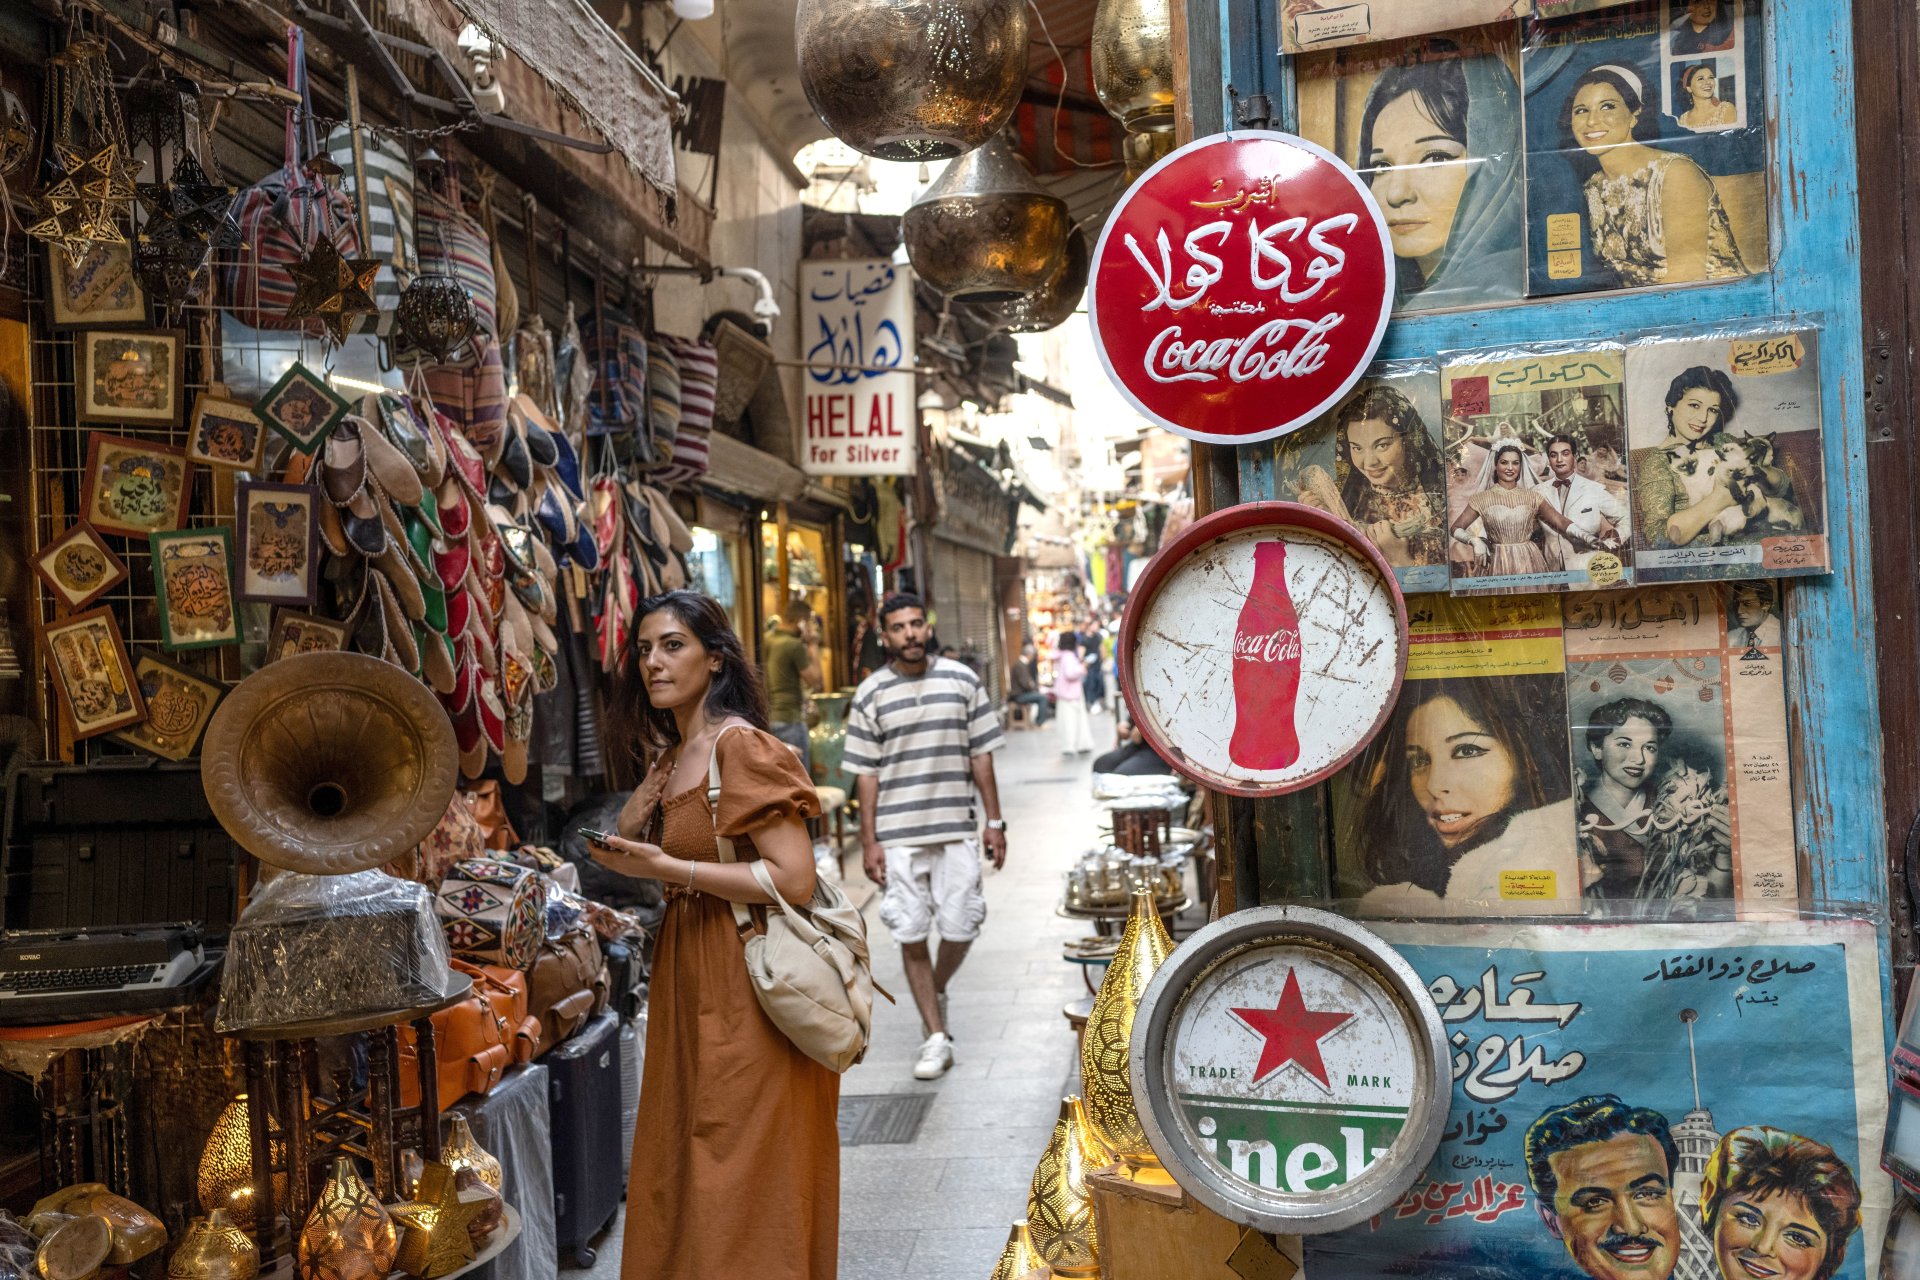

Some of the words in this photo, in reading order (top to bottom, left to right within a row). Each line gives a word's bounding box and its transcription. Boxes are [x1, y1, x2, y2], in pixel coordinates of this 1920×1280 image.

[1124, 219, 1234, 312] كولا
[1248, 212, 1359, 304] كوكا
[811, 263, 897, 306] فضيات
[1143, 311, 1345, 384] Coca-Cola
[1734, 339, 1797, 366] الكواكب
[1495, 361, 1616, 388] الكواكب
[807, 392, 904, 440] HELAL
[810, 445, 838, 464] For
[846, 444, 901, 464] Silver
[1233, 627, 1301, 664] Coca-Cola
[1746, 957, 1816, 984] صلاح
[1734, 990, 1779, 1018] يقدم
[1188, 1065, 1237, 1080] TRADE
[1346, 1073, 1392, 1089] MARK
[1463, 1033, 1587, 1105] صلاح
[1441, 1106, 1508, 1146] فؤاد
